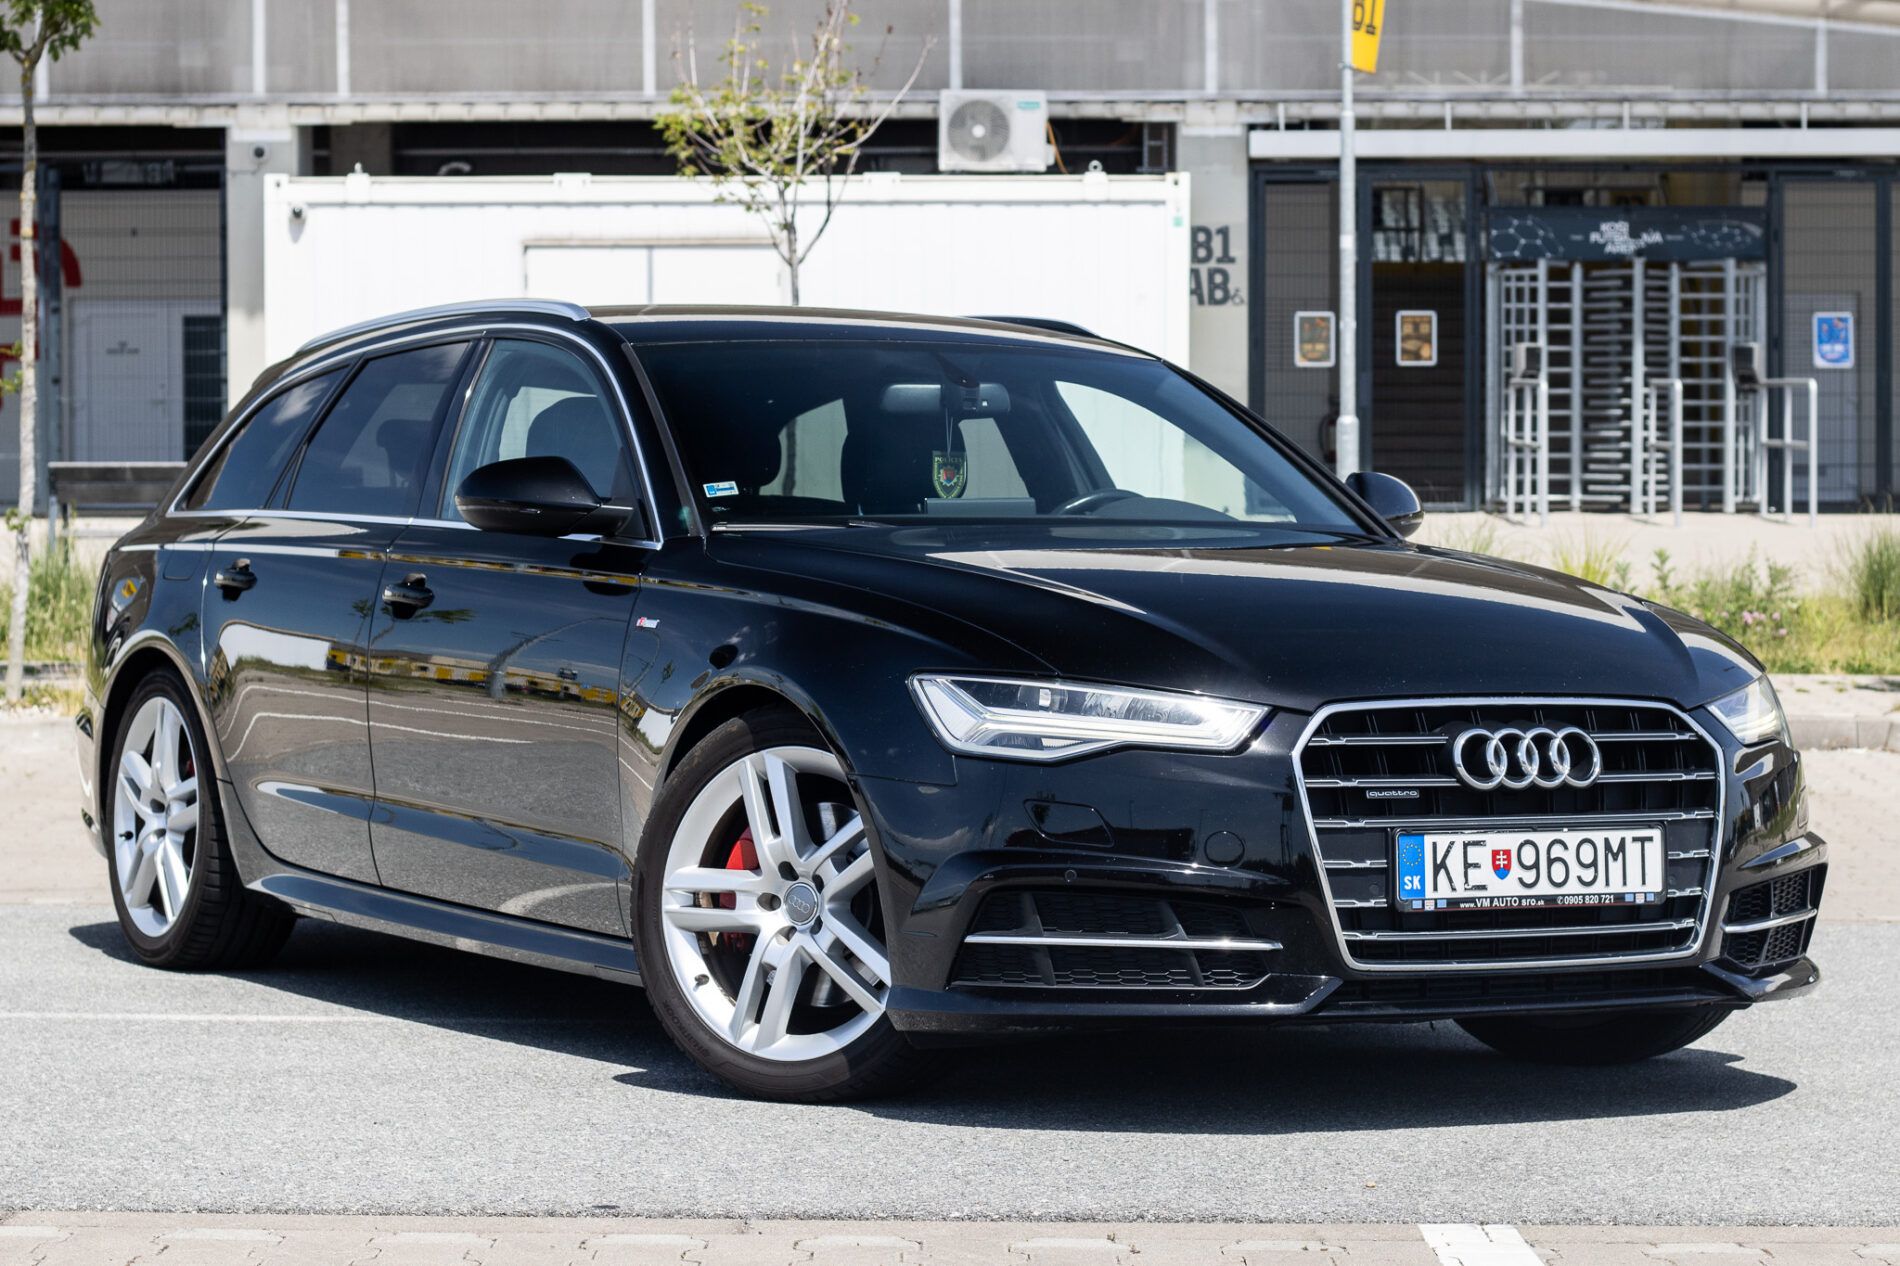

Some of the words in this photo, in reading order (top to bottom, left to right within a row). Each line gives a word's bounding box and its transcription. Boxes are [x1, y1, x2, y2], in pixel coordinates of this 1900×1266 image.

[1190, 225, 1236, 264] B1
[1369, 790, 1418, 798] quattro
[1432, 839, 1488, 892] KE
[1516, 836, 1654, 889] 969MT
[1403, 875, 1421, 890] SK
[1492, 896, 1519, 907] AUTO
[1564, 895, 1584, 905] 0905
[1585, 894, 1599, 904] 820
[1601, 894, 1614, 904] 721
